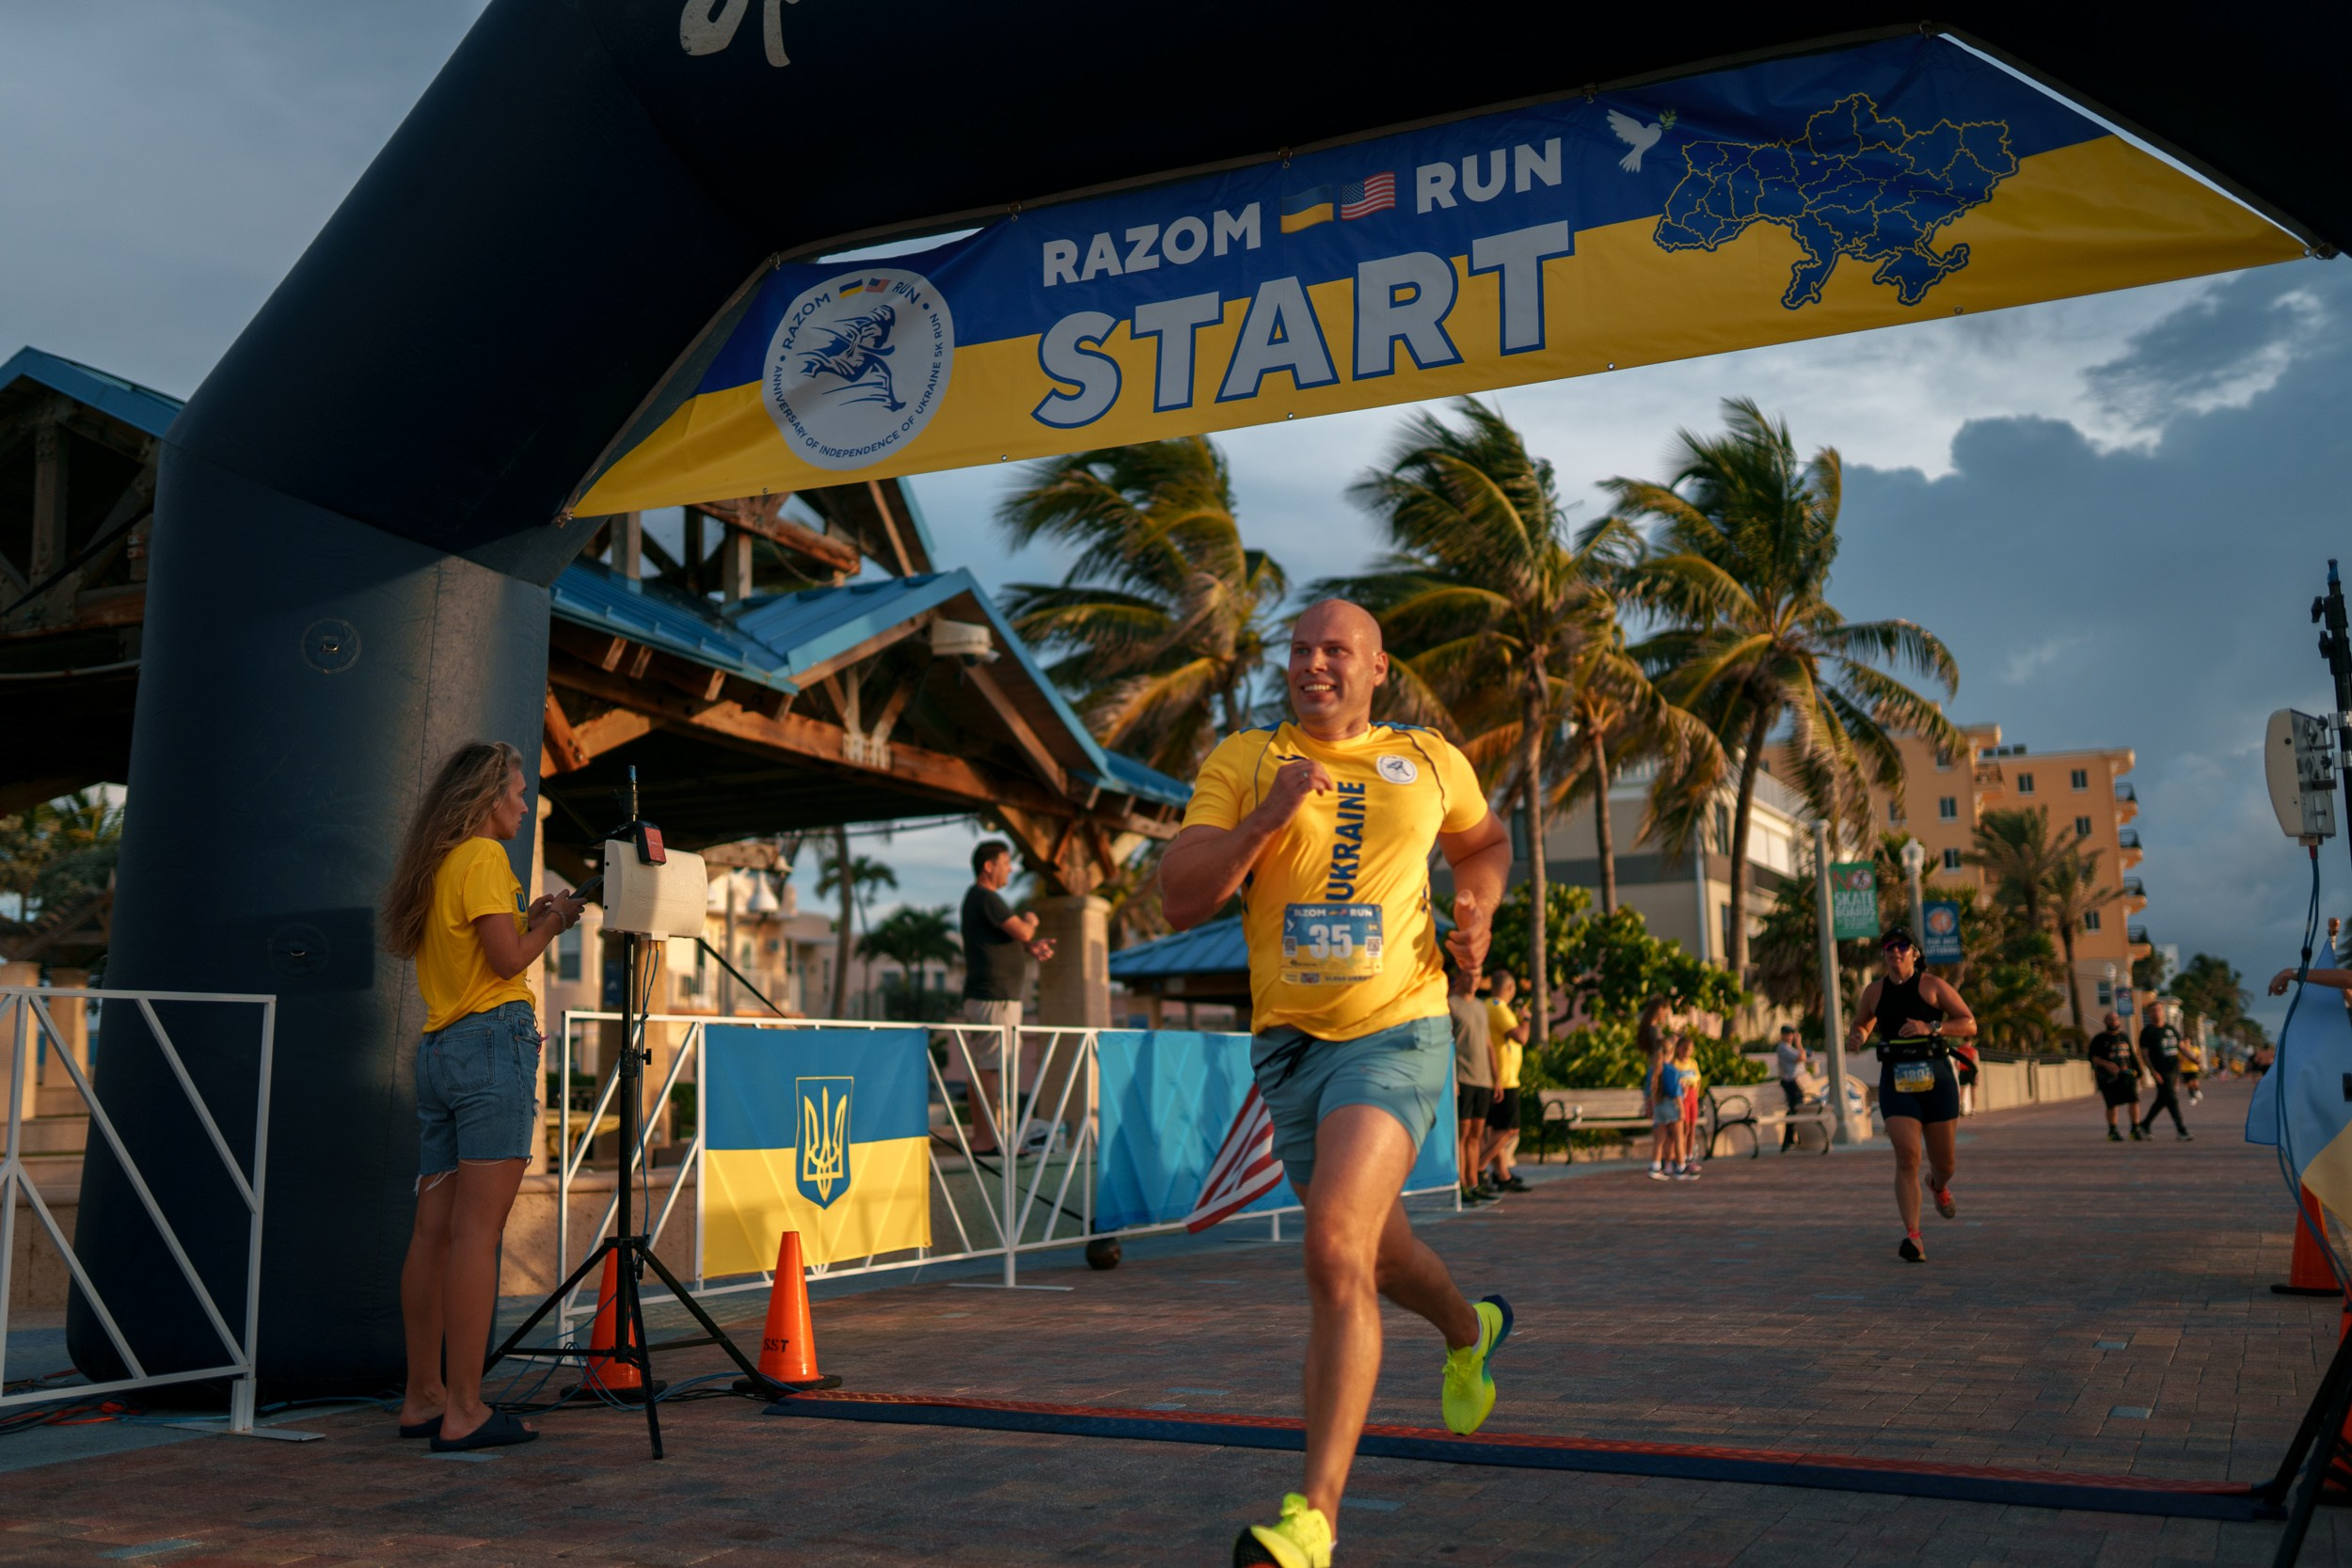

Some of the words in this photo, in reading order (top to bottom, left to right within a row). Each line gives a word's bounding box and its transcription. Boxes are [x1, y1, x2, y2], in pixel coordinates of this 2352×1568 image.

[1042, 201, 1262, 288] RAZOM
[1416, 136, 1563, 214] RUN
[782, 293, 832, 351] RAZOM
[892, 281, 922, 306] RUN
[930, 312, 944, 340] RUN
[1030, 217, 1576, 430] START
[934, 341, 944, 358] 5K
[773, 365, 807, 439] ANNIVERSARY
[915, 361, 942, 415] UKRAINE
[901, 415, 915, 433] OF
[805, 436, 820, 450] OF
[818, 431, 900, 459] INDEPENDENCE
[1325, 781, 1367, 901] UKRAINE
[1835, 890, 1874, 905] SKATE
[1836, 903, 1876, 919] BOARDS
[1349, 908, 1373, 918] RUN
[1309, 923, 1353, 959] 35
[763, 1338, 789, 1353] SST
